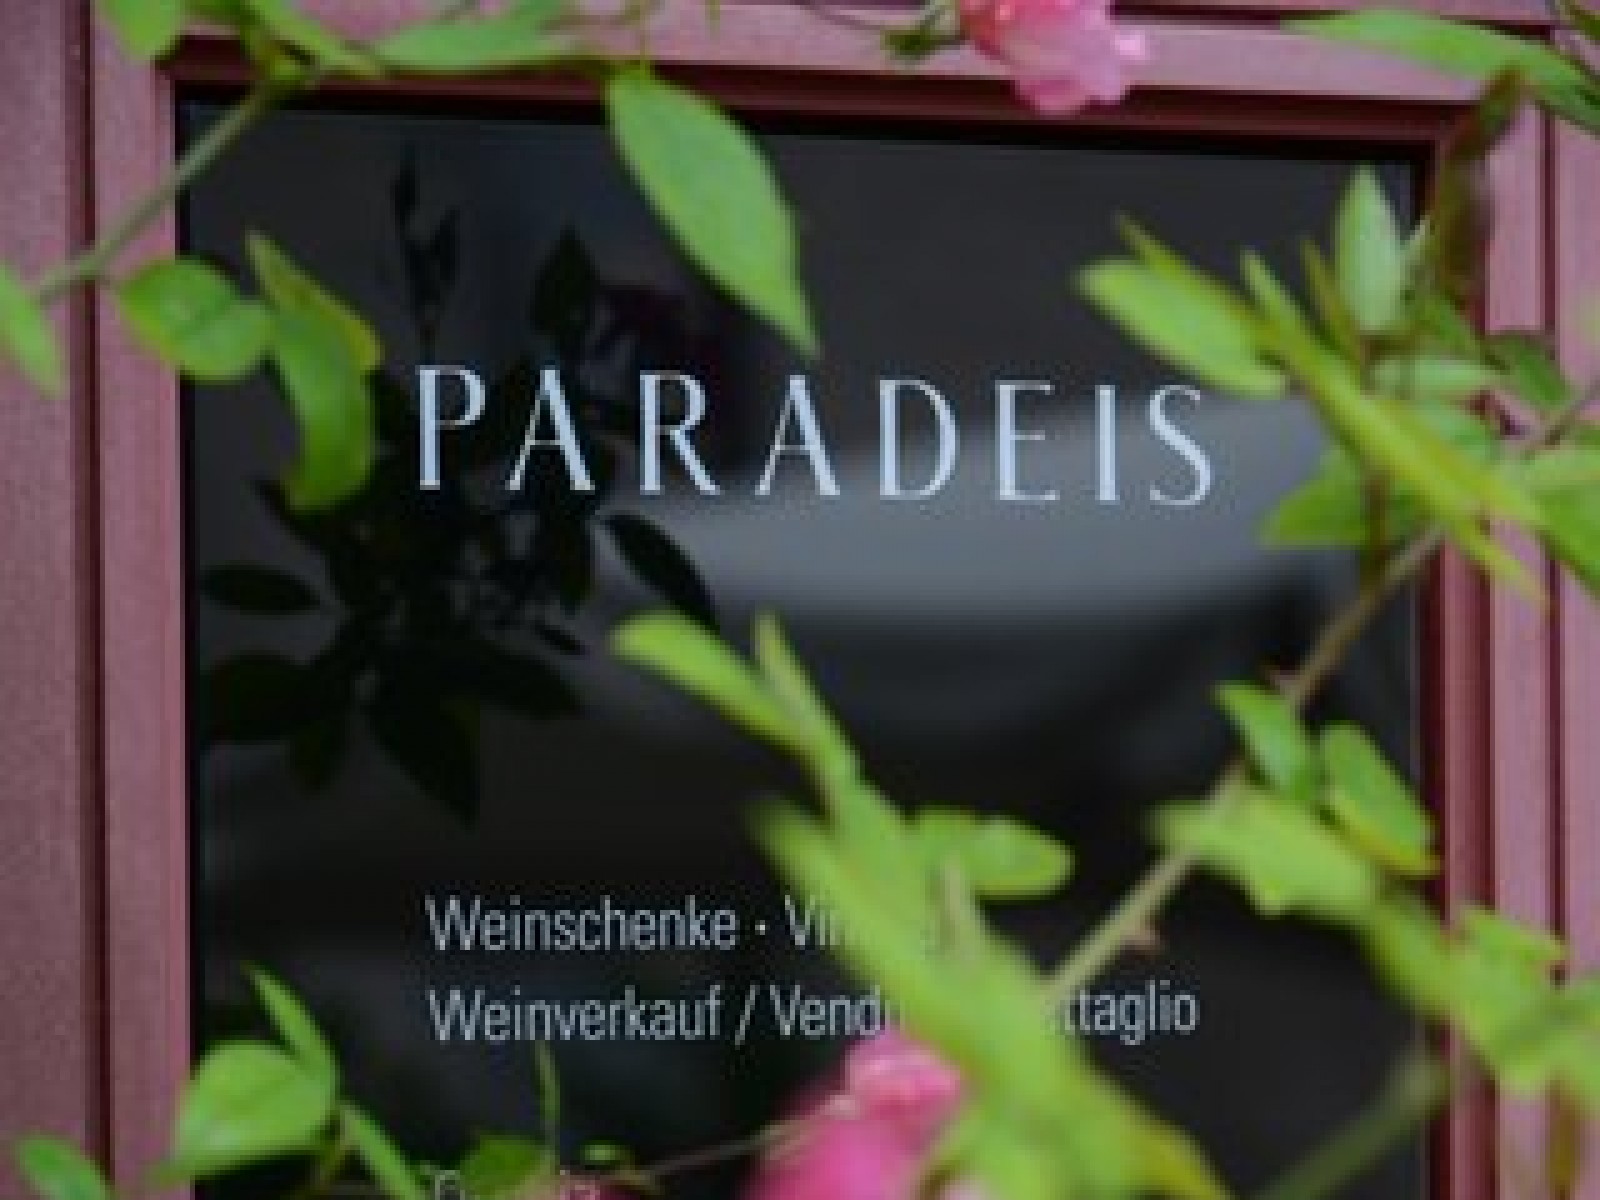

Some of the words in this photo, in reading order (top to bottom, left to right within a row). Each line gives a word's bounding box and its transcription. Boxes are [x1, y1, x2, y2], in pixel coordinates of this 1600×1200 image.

[415, 364, 1213, 507] PARADEIS
[425, 894, 737, 951] Weinschenke
[427, 984, 722, 1042] Weinverkauf
